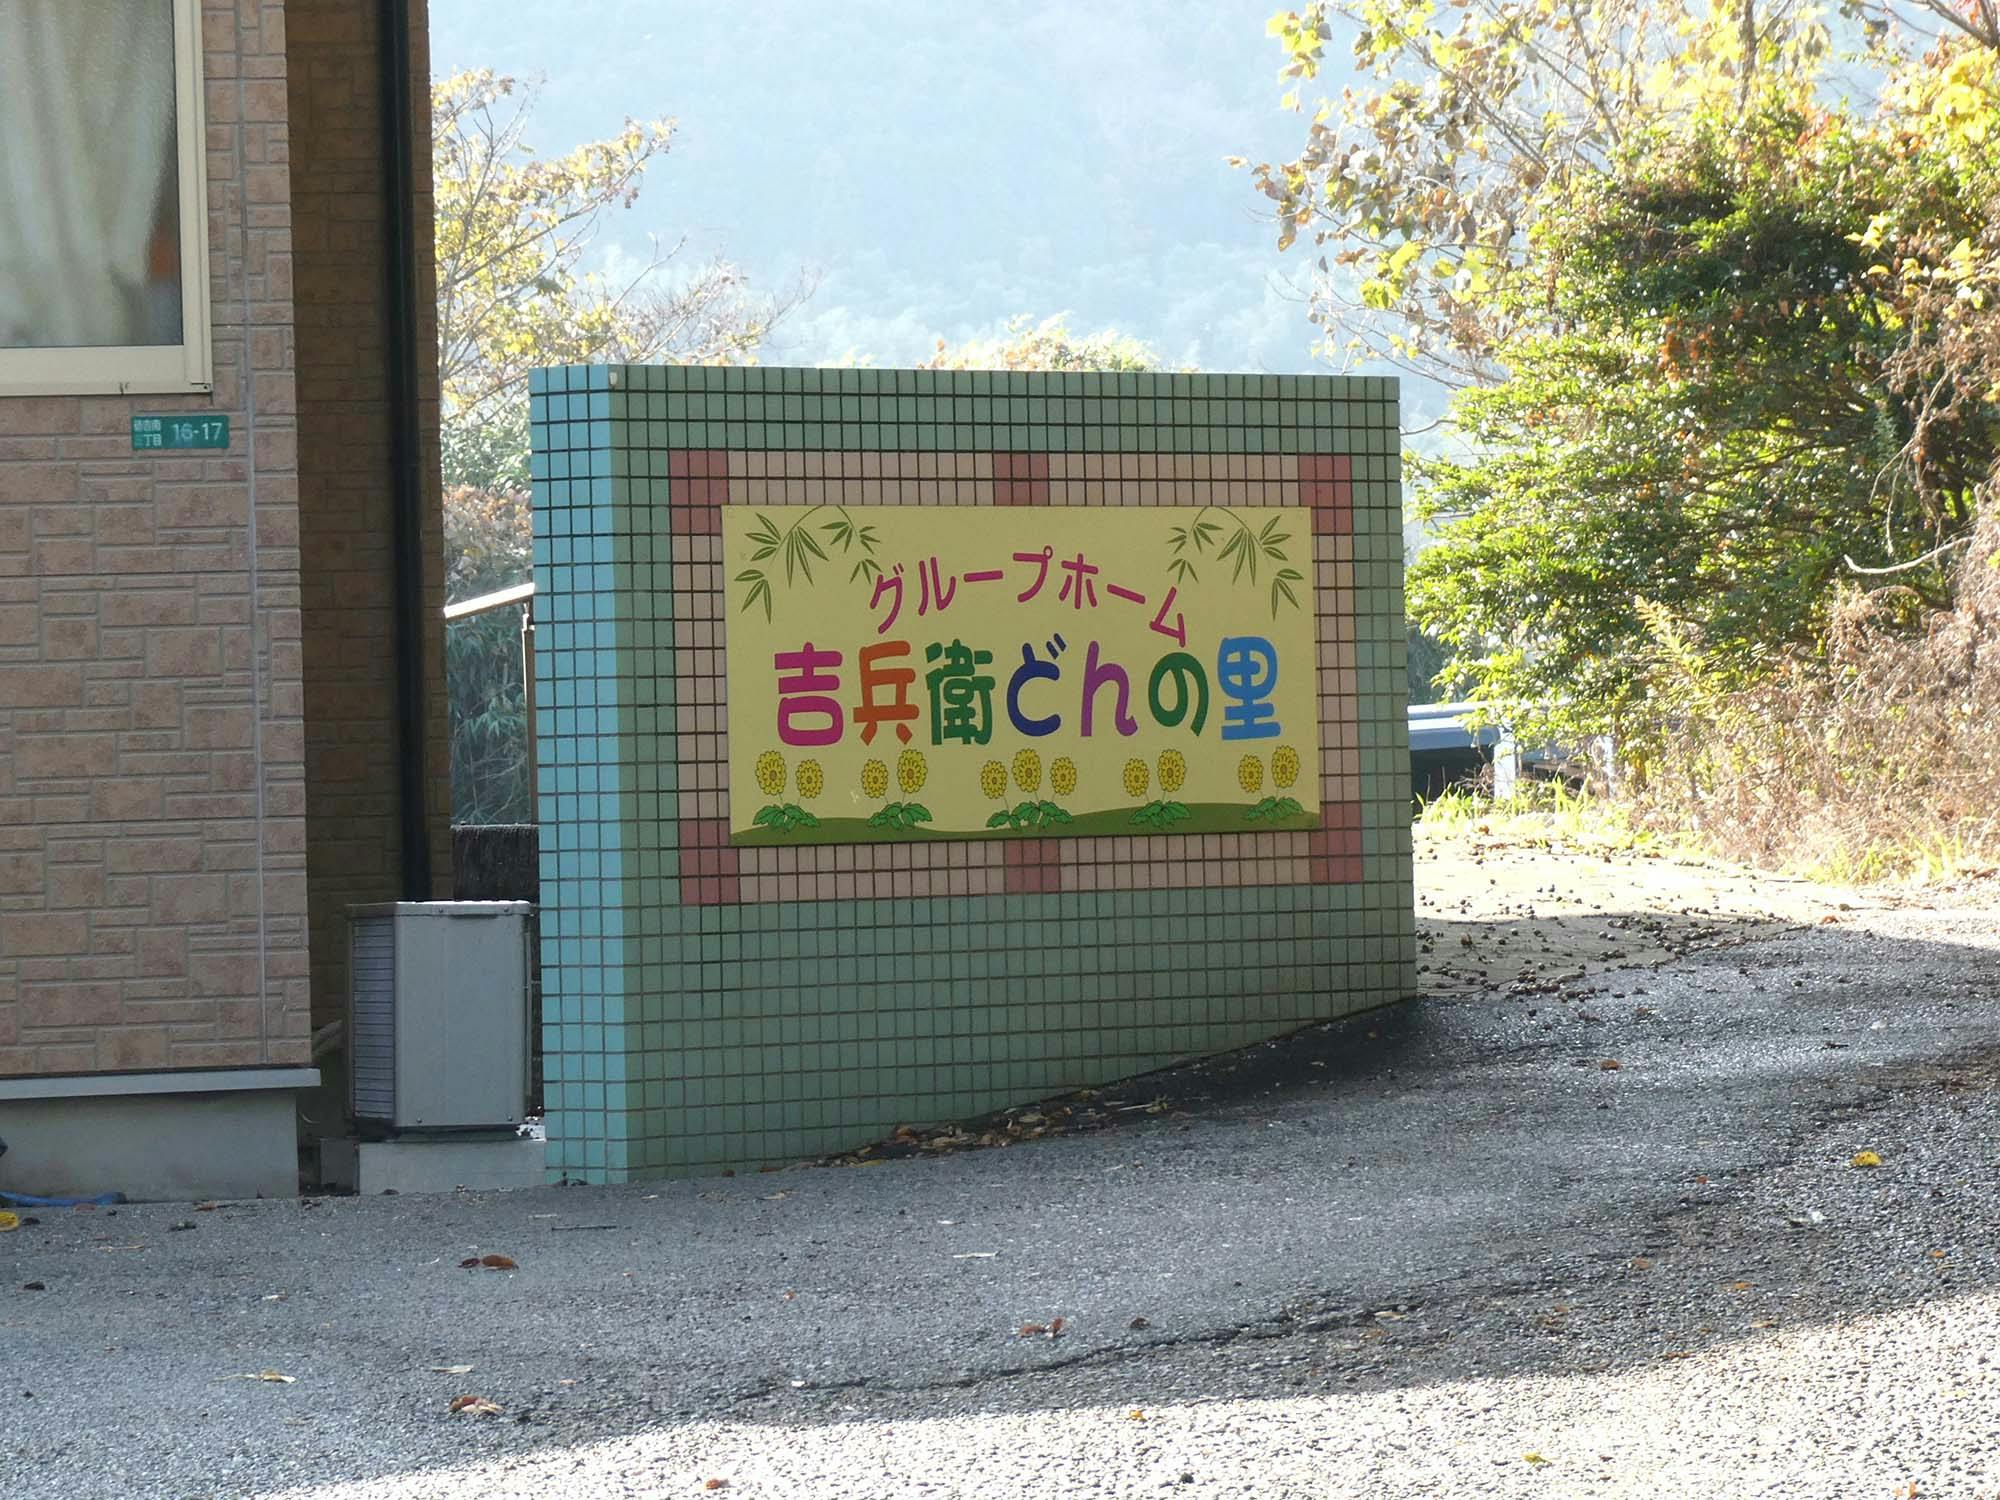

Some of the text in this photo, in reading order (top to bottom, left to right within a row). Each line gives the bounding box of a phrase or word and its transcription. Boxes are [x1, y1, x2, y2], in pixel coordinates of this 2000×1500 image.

[171, 422, 222, 440] 16-17
[870, 546, 1187, 648] グループホーム
[774, 633, 1282, 746] 吉兵衛どんの里
